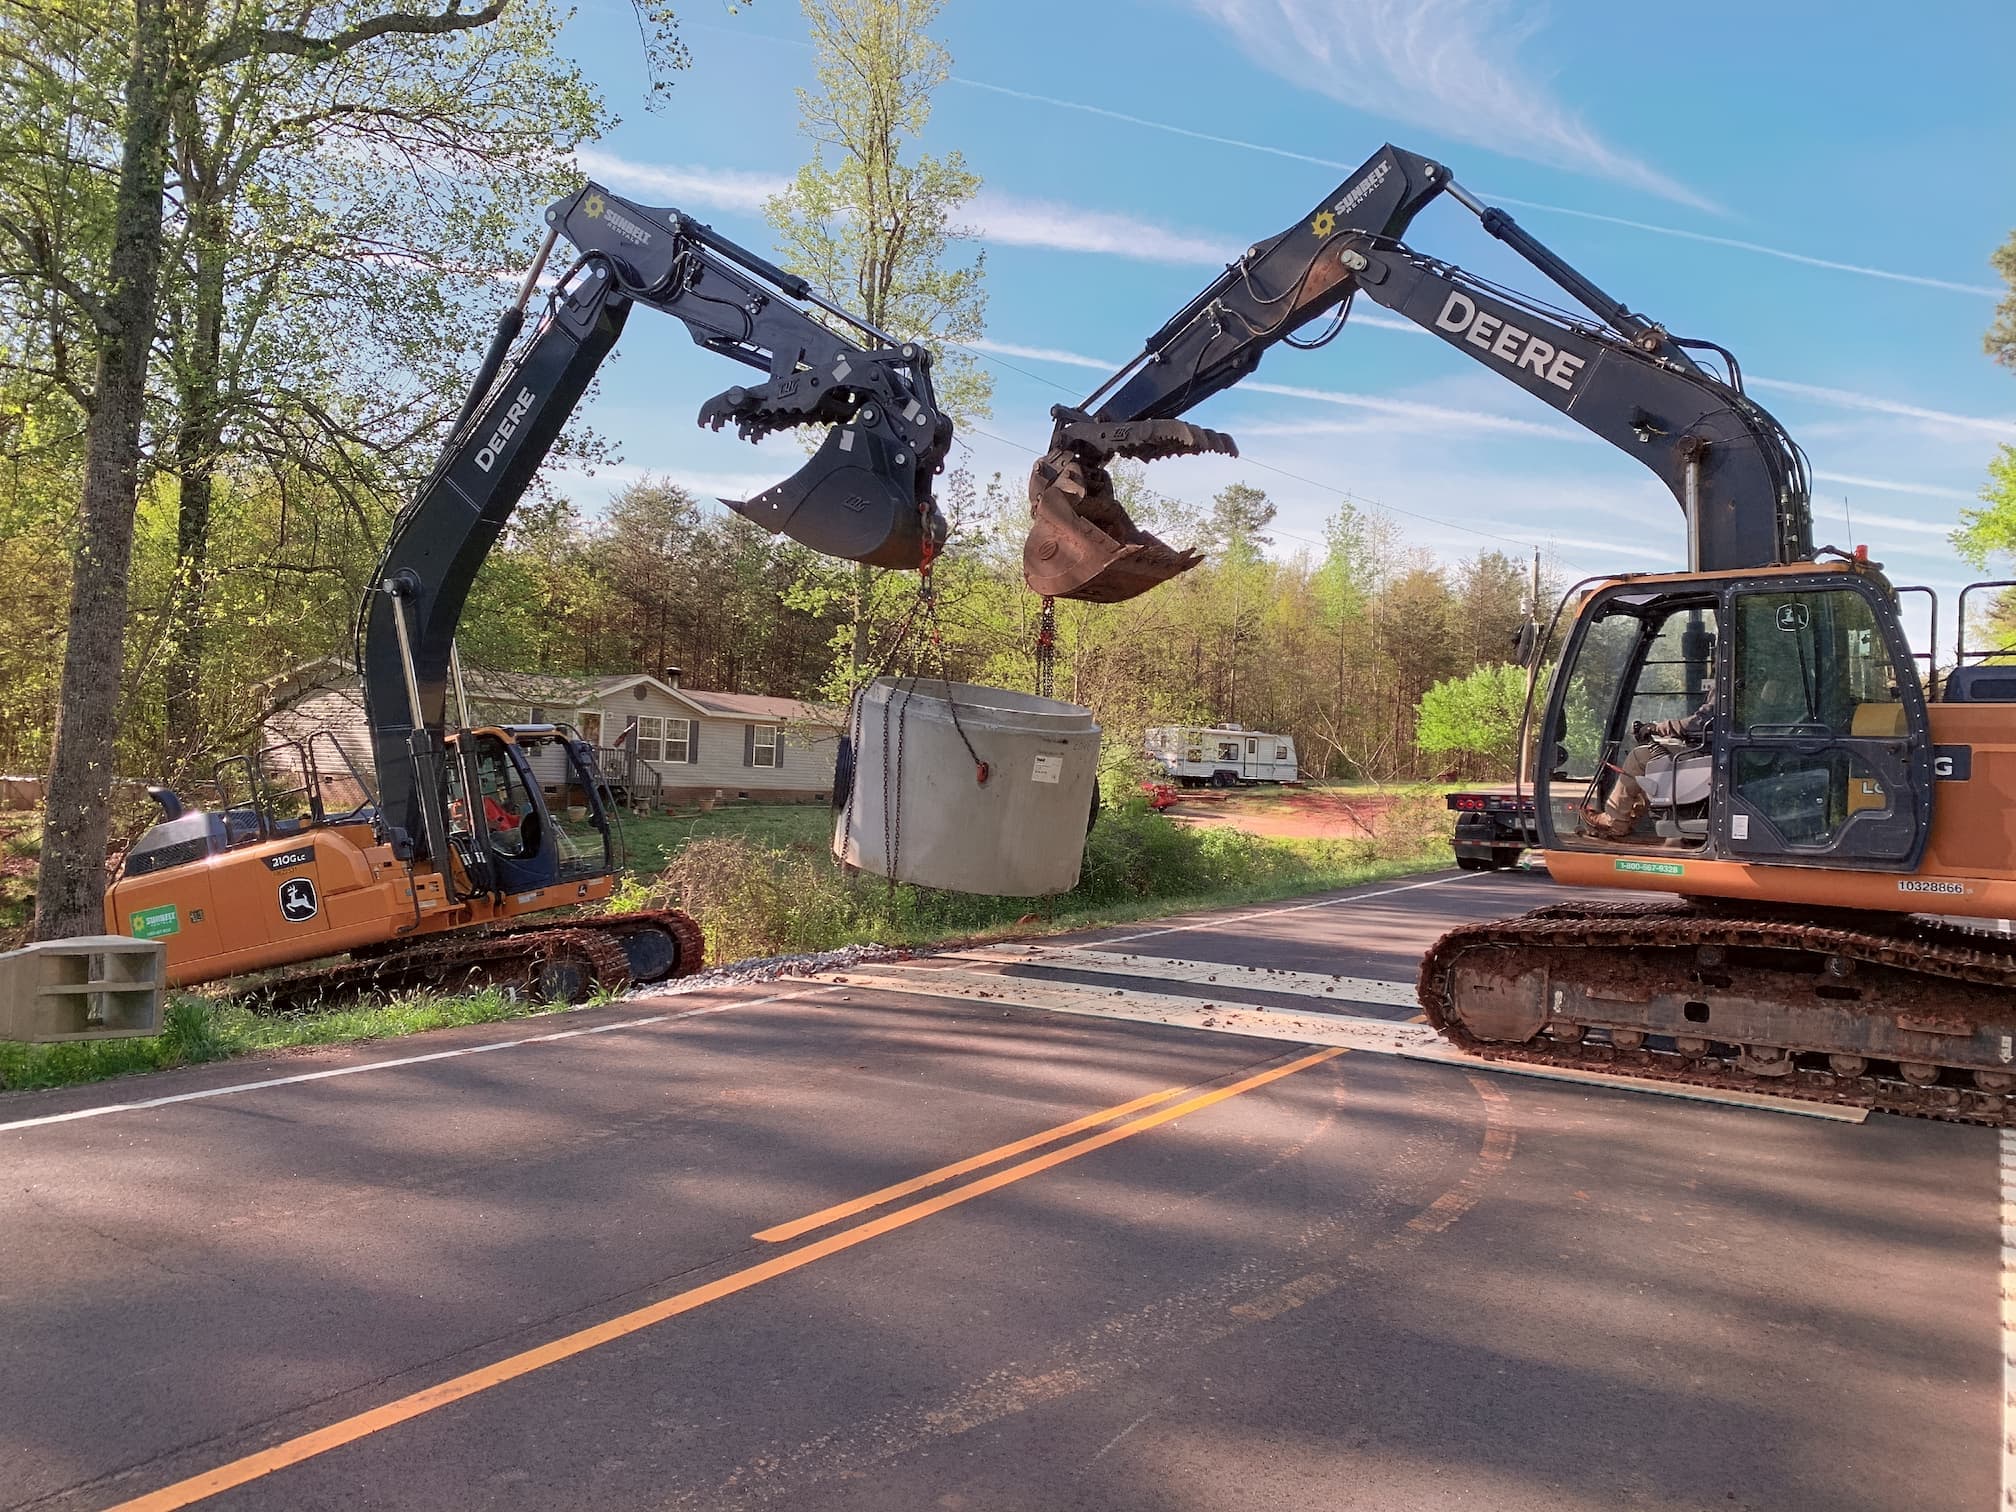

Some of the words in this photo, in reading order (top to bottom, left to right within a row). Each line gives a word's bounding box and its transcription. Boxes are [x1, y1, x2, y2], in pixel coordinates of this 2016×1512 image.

[1334, 160, 1387, 216] SUNBELT
[1346, 177, 1385, 214] RENTALS
[603, 208, 651, 246] SUNBELT
[607, 222, 640, 246] RENTALS
[1435, 290, 1586, 391] DEERE
[474, 386, 536, 473] DEERE
[1899, 880, 1963, 894] 10328866
